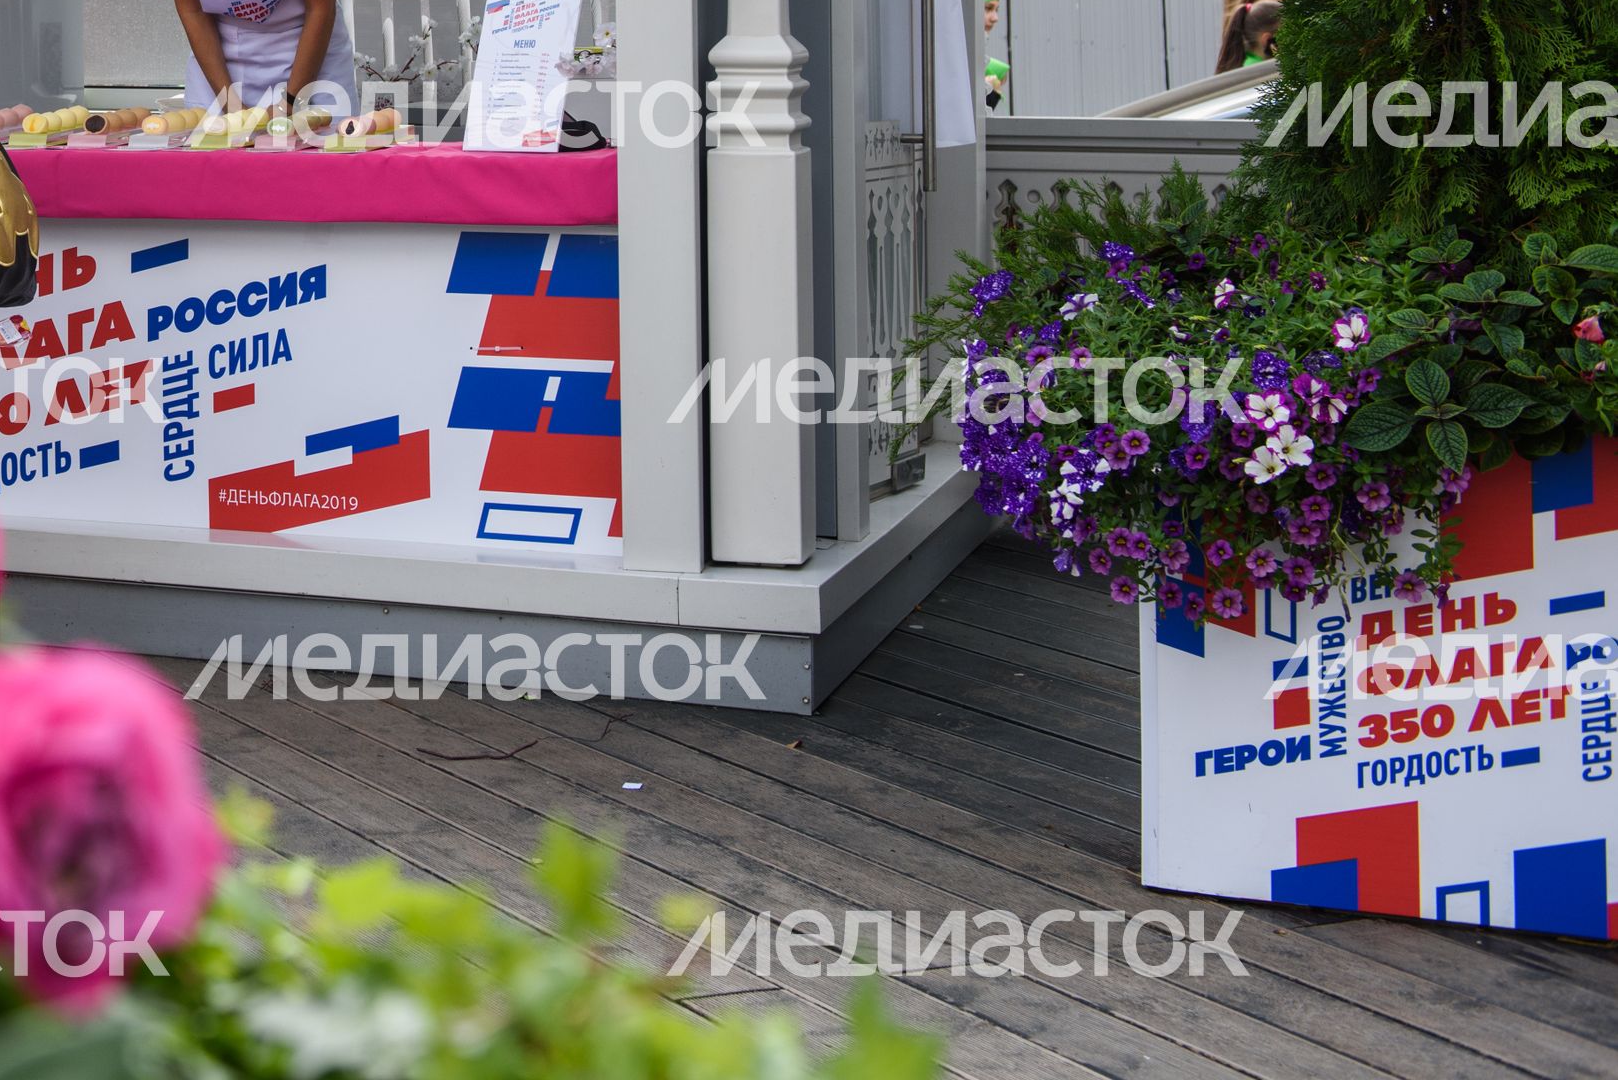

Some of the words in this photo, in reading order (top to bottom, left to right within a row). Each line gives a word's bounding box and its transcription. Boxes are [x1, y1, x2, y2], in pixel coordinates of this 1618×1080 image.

[513, 39, 536, 49] МЕНЮ
[147, 264, 327, 343] РОССИЯ
[208, 328, 293, 379] СИЛА
[44, 359, 154, 426] ЛЕТ
[163, 350, 200, 482] СЕРДЦЕ
[218, 488, 359, 511] #ДЕНЬФЛАГА2019
[1356, 592, 1517, 651] ДЕНЬ
[1317, 615, 1348, 758] МУЖЕСТВО
[1356, 636, 1555, 695] ФЛАГА
[1358, 704, 1455, 748] 350
[1467, 684, 1573, 734] ЛЕТ
[1581, 679, 1618, 782] СЕРДЦЕ
[1195, 735, 1311, 777] ГЕРОИ
[1357, 744, 1494, 789] ГОРДОСТЬ
